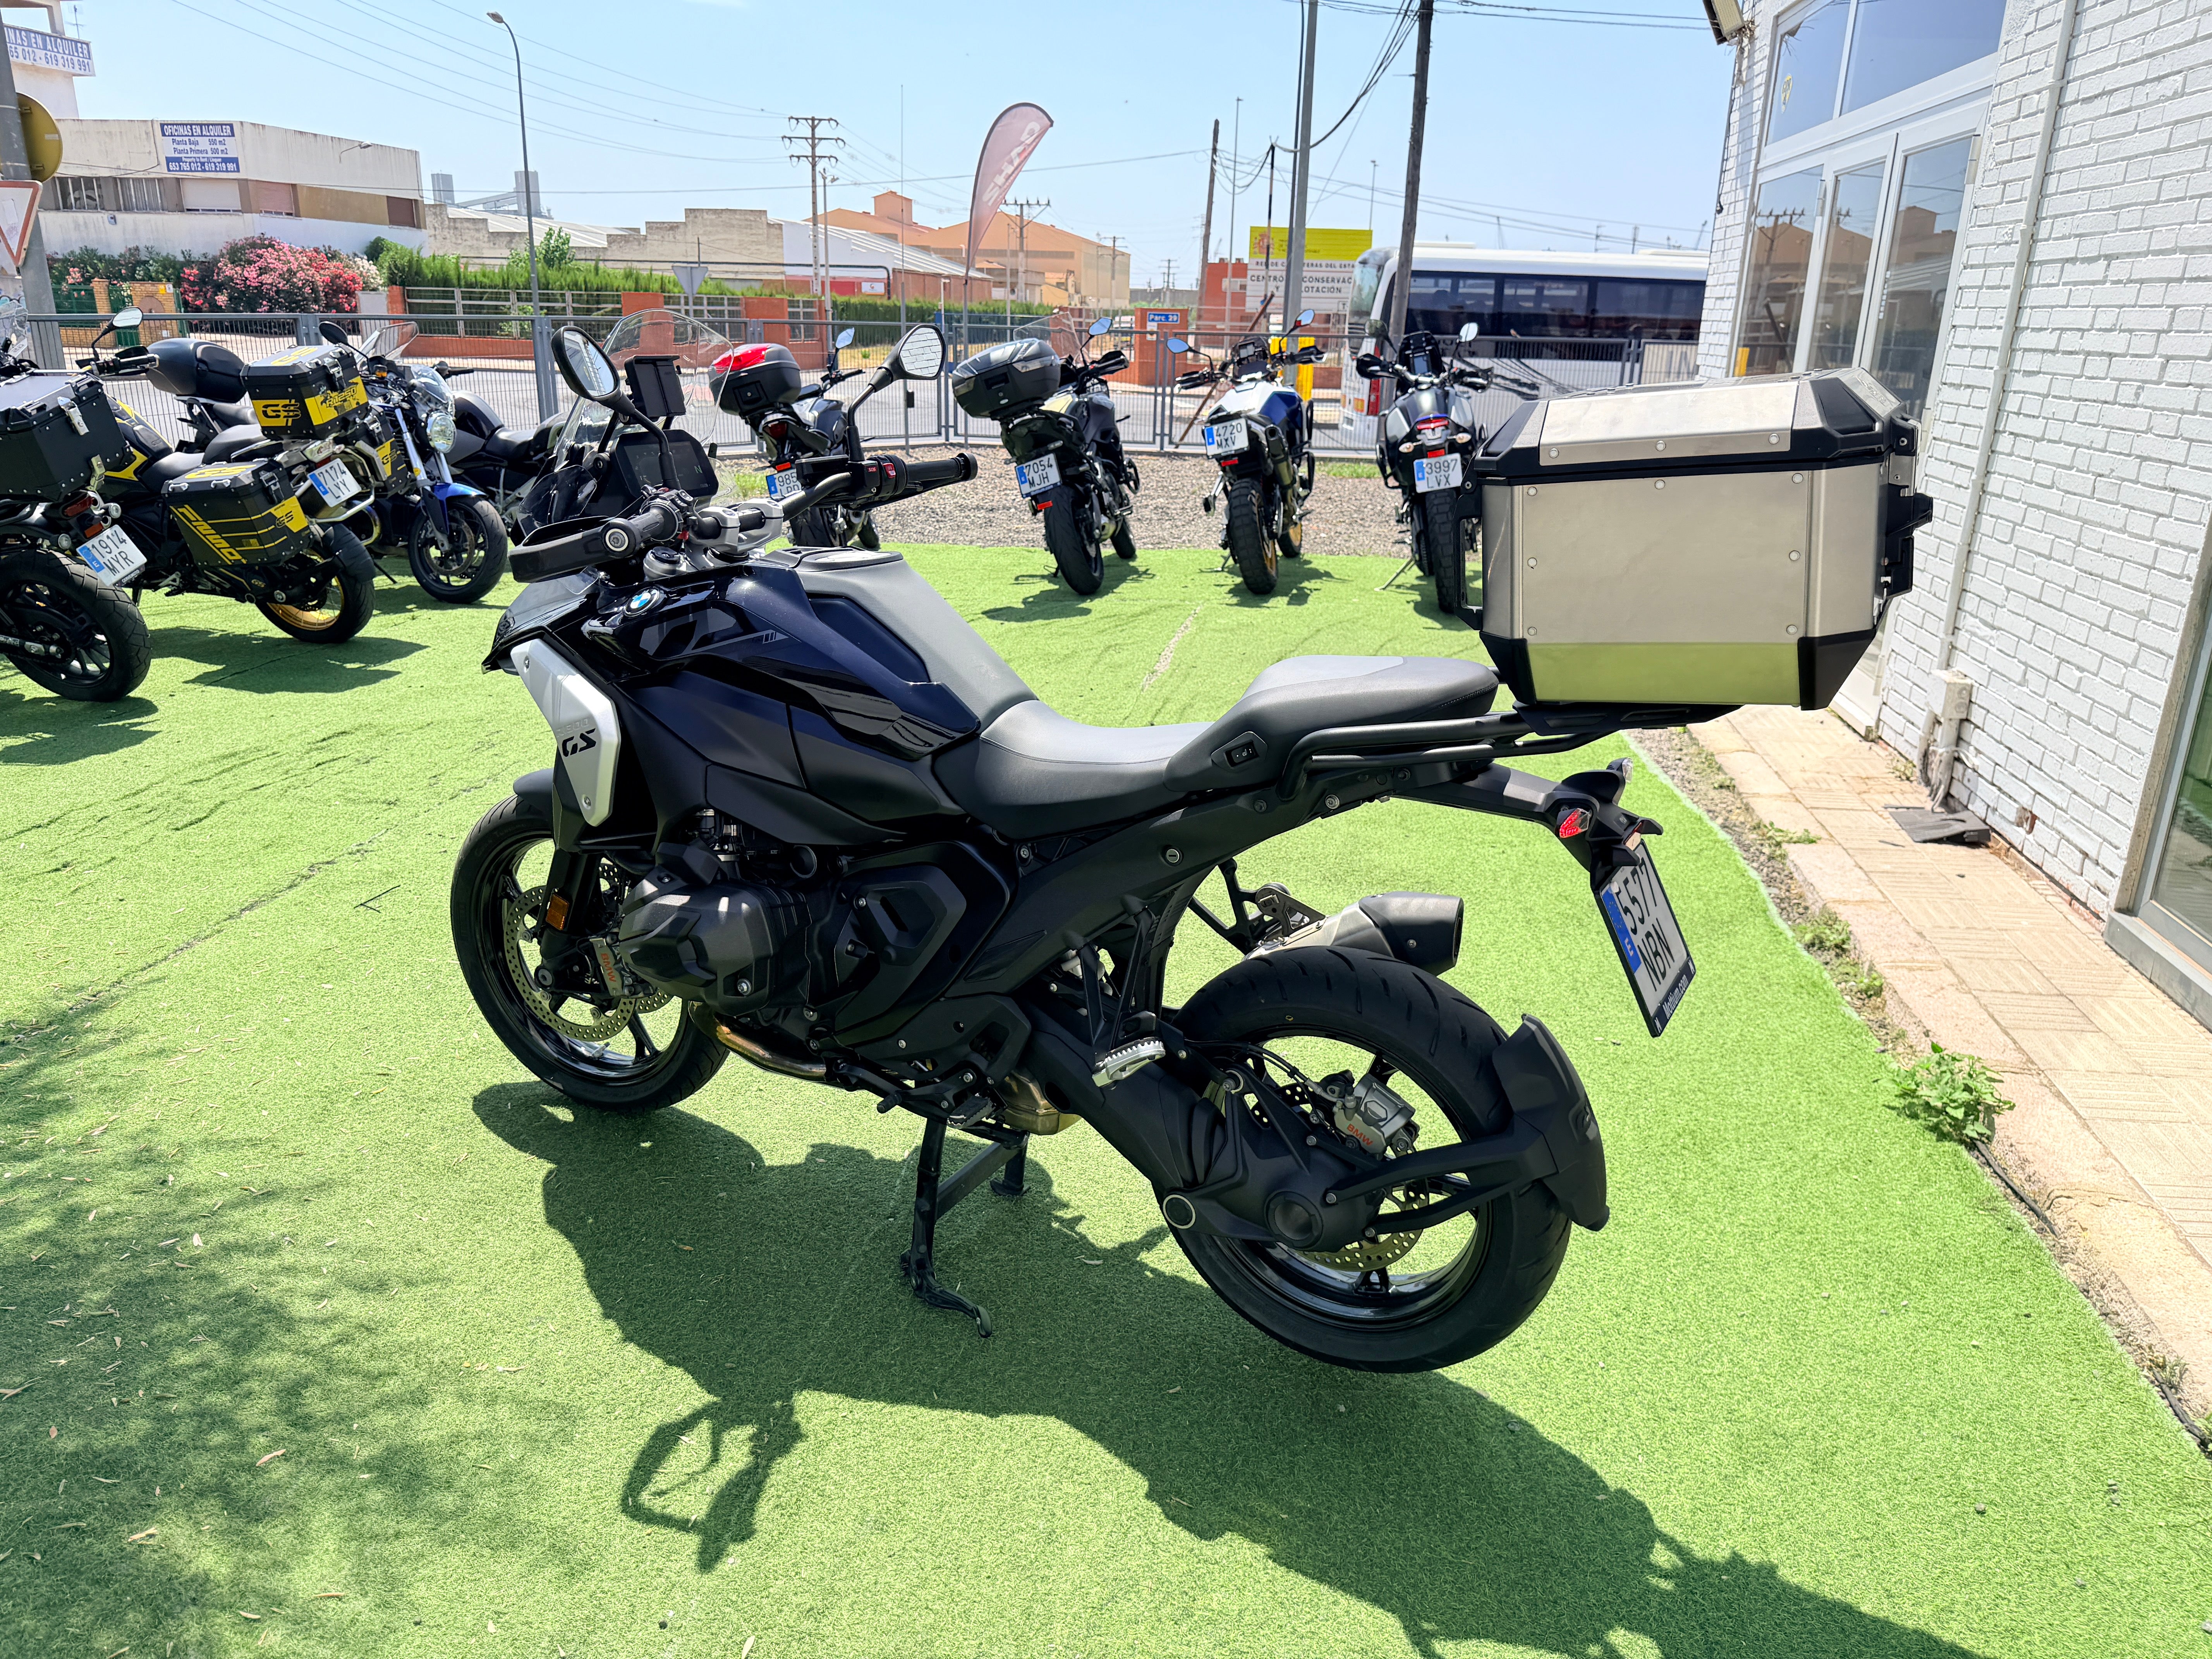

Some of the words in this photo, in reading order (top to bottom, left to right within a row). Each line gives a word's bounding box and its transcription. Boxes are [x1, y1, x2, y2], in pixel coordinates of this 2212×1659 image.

[4, 27, 27, 46] INAS
[30, 33, 43, 49] EN
[46, 36, 89, 58] ALQUILER
[9, 45, 19, 59] 65
[22, 48, 37, 62] 012
[45, 52, 58, 66] 619
[61, 55, 74, 69] 319
[77, 59, 90, 72] 991
[164, 125, 192, 136] OFICINAS
[192, 125, 201, 136] EN
[202, 125, 232, 136] ALQUILER
[188, 138, 199, 146] Baja
[169, 162, 179, 170] 653
[180, 162, 190, 170] 765
[191, 162, 201, 171] 012
[204, 163, 215, 171] 619
[216, 163, 226, 171] 319
[227, 163, 237, 171] 991
[326, 386, 357, 408] R1250
[262, 404, 301, 419] GS
[1216, 423, 1242, 437] 4720
[1216, 435, 1236, 449] MXV
[318, 463, 347, 486] 7174
[1025, 458, 1053, 476] 7054
[1425, 459, 1457, 475] 3997
[778, 472, 797, 486] 985
[1028, 472, 1049, 488] MJH
[1427, 474, 1450, 489] LVX
[328, 479, 350, 499] LYY
[276, 510, 294, 528] GS
[91, 530, 127, 558] 1914
[103, 551, 134, 576] MYR
[562, 728, 596, 757] GS
[1615, 857, 1657, 936] 5577
[1624, 938, 1634, 957] E
[1637, 918, 1675, 992] NBN
[601, 953, 617, 982] BMW
[1662, 974, 1688, 1020] Mottium.com
[1347, 1123, 1374, 1146] BMW
